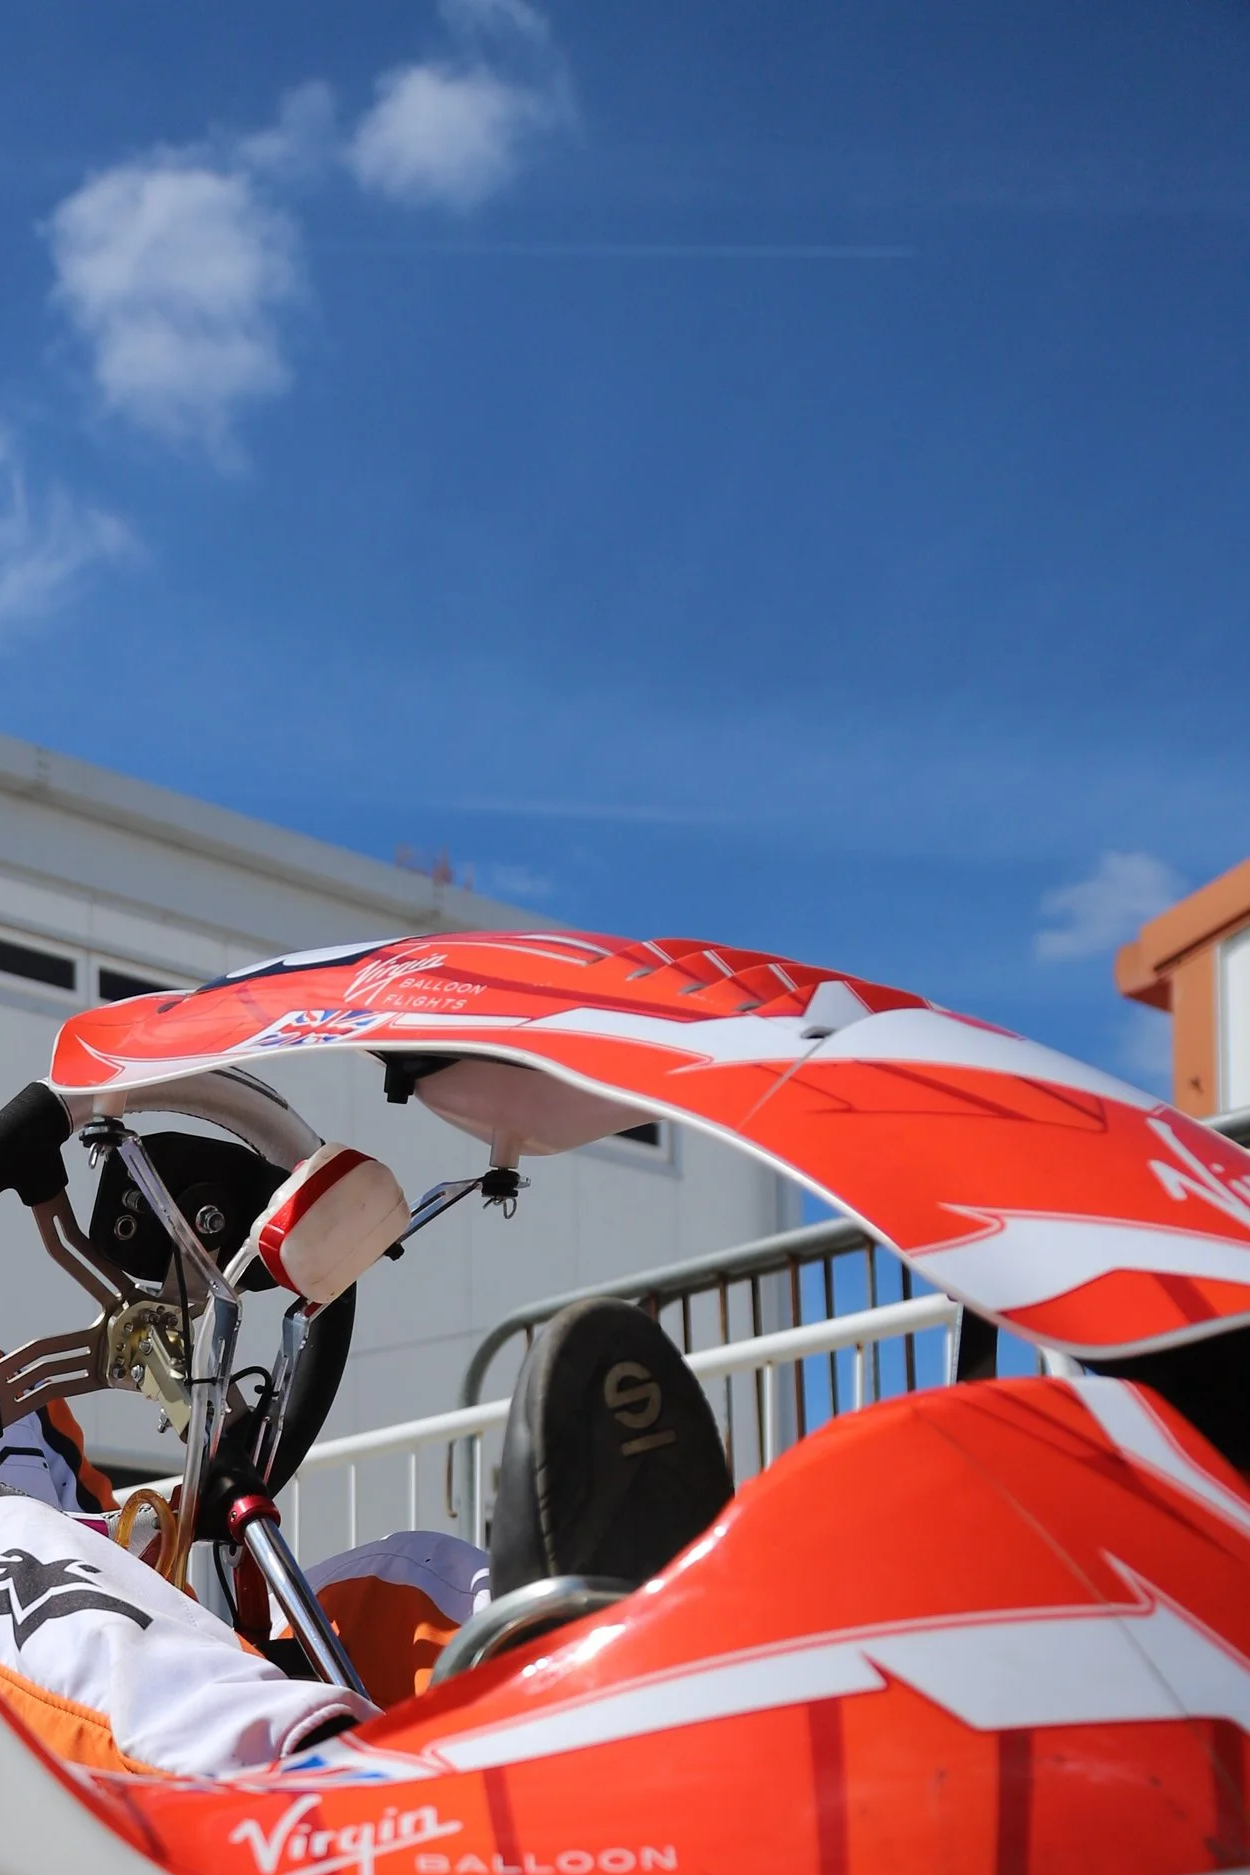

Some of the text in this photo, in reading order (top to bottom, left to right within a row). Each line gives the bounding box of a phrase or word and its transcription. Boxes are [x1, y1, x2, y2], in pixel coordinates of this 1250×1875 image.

[343, 944, 448, 1006] Virgin
[400, 978, 487, 994] BALLOON
[382, 994, 467, 1009] FLIGHTS
